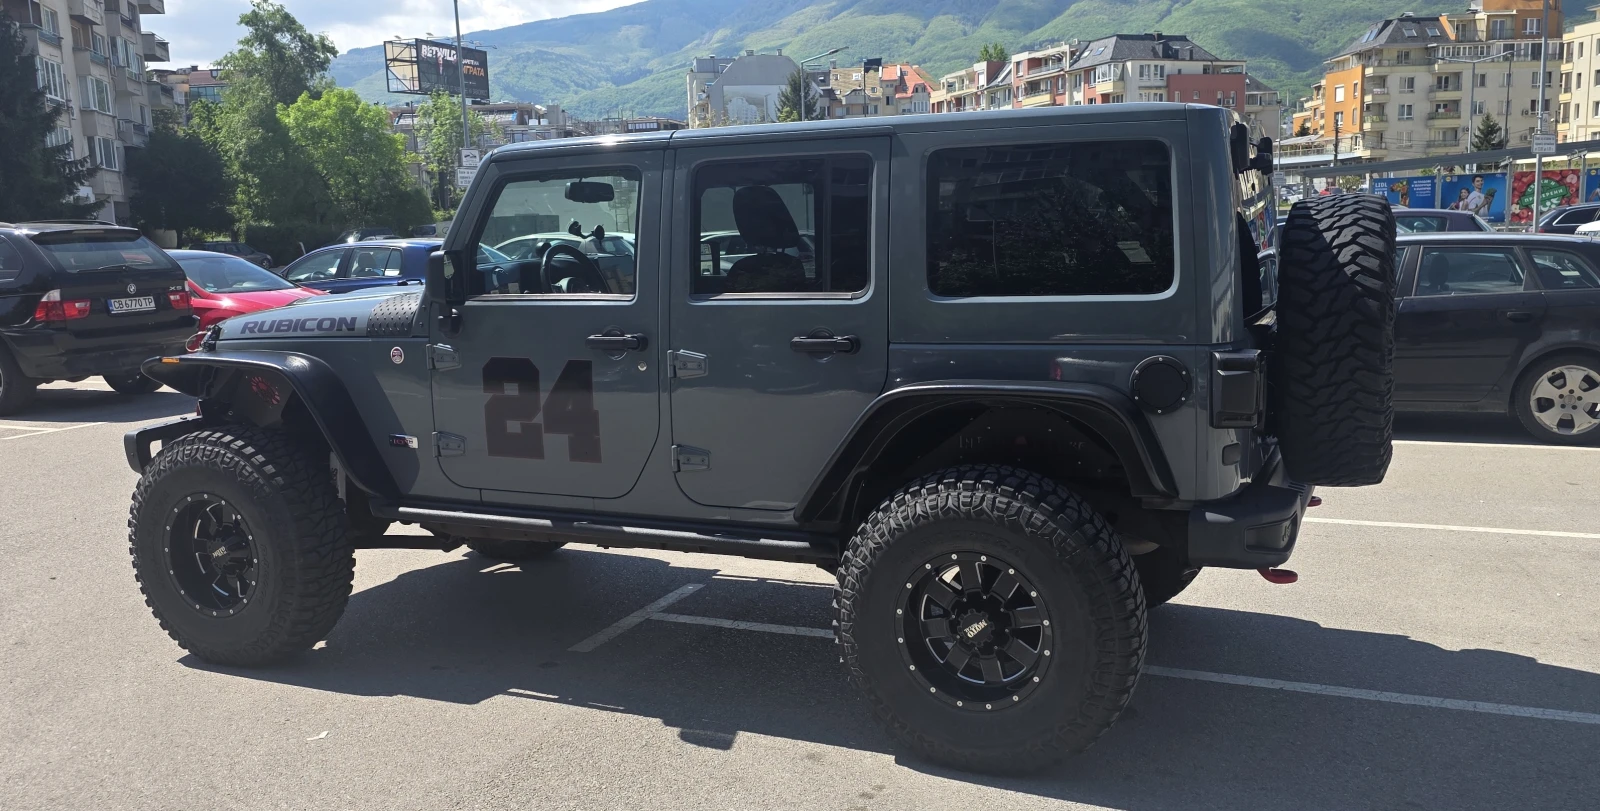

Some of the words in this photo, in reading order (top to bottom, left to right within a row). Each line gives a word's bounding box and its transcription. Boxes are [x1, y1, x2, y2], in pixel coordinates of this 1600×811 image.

[124, 298, 143, 308] 6770
[240, 317, 357, 334] RUBICON
[482, 357, 602, 463] 24
[967, 619, 988, 638] MOTO
